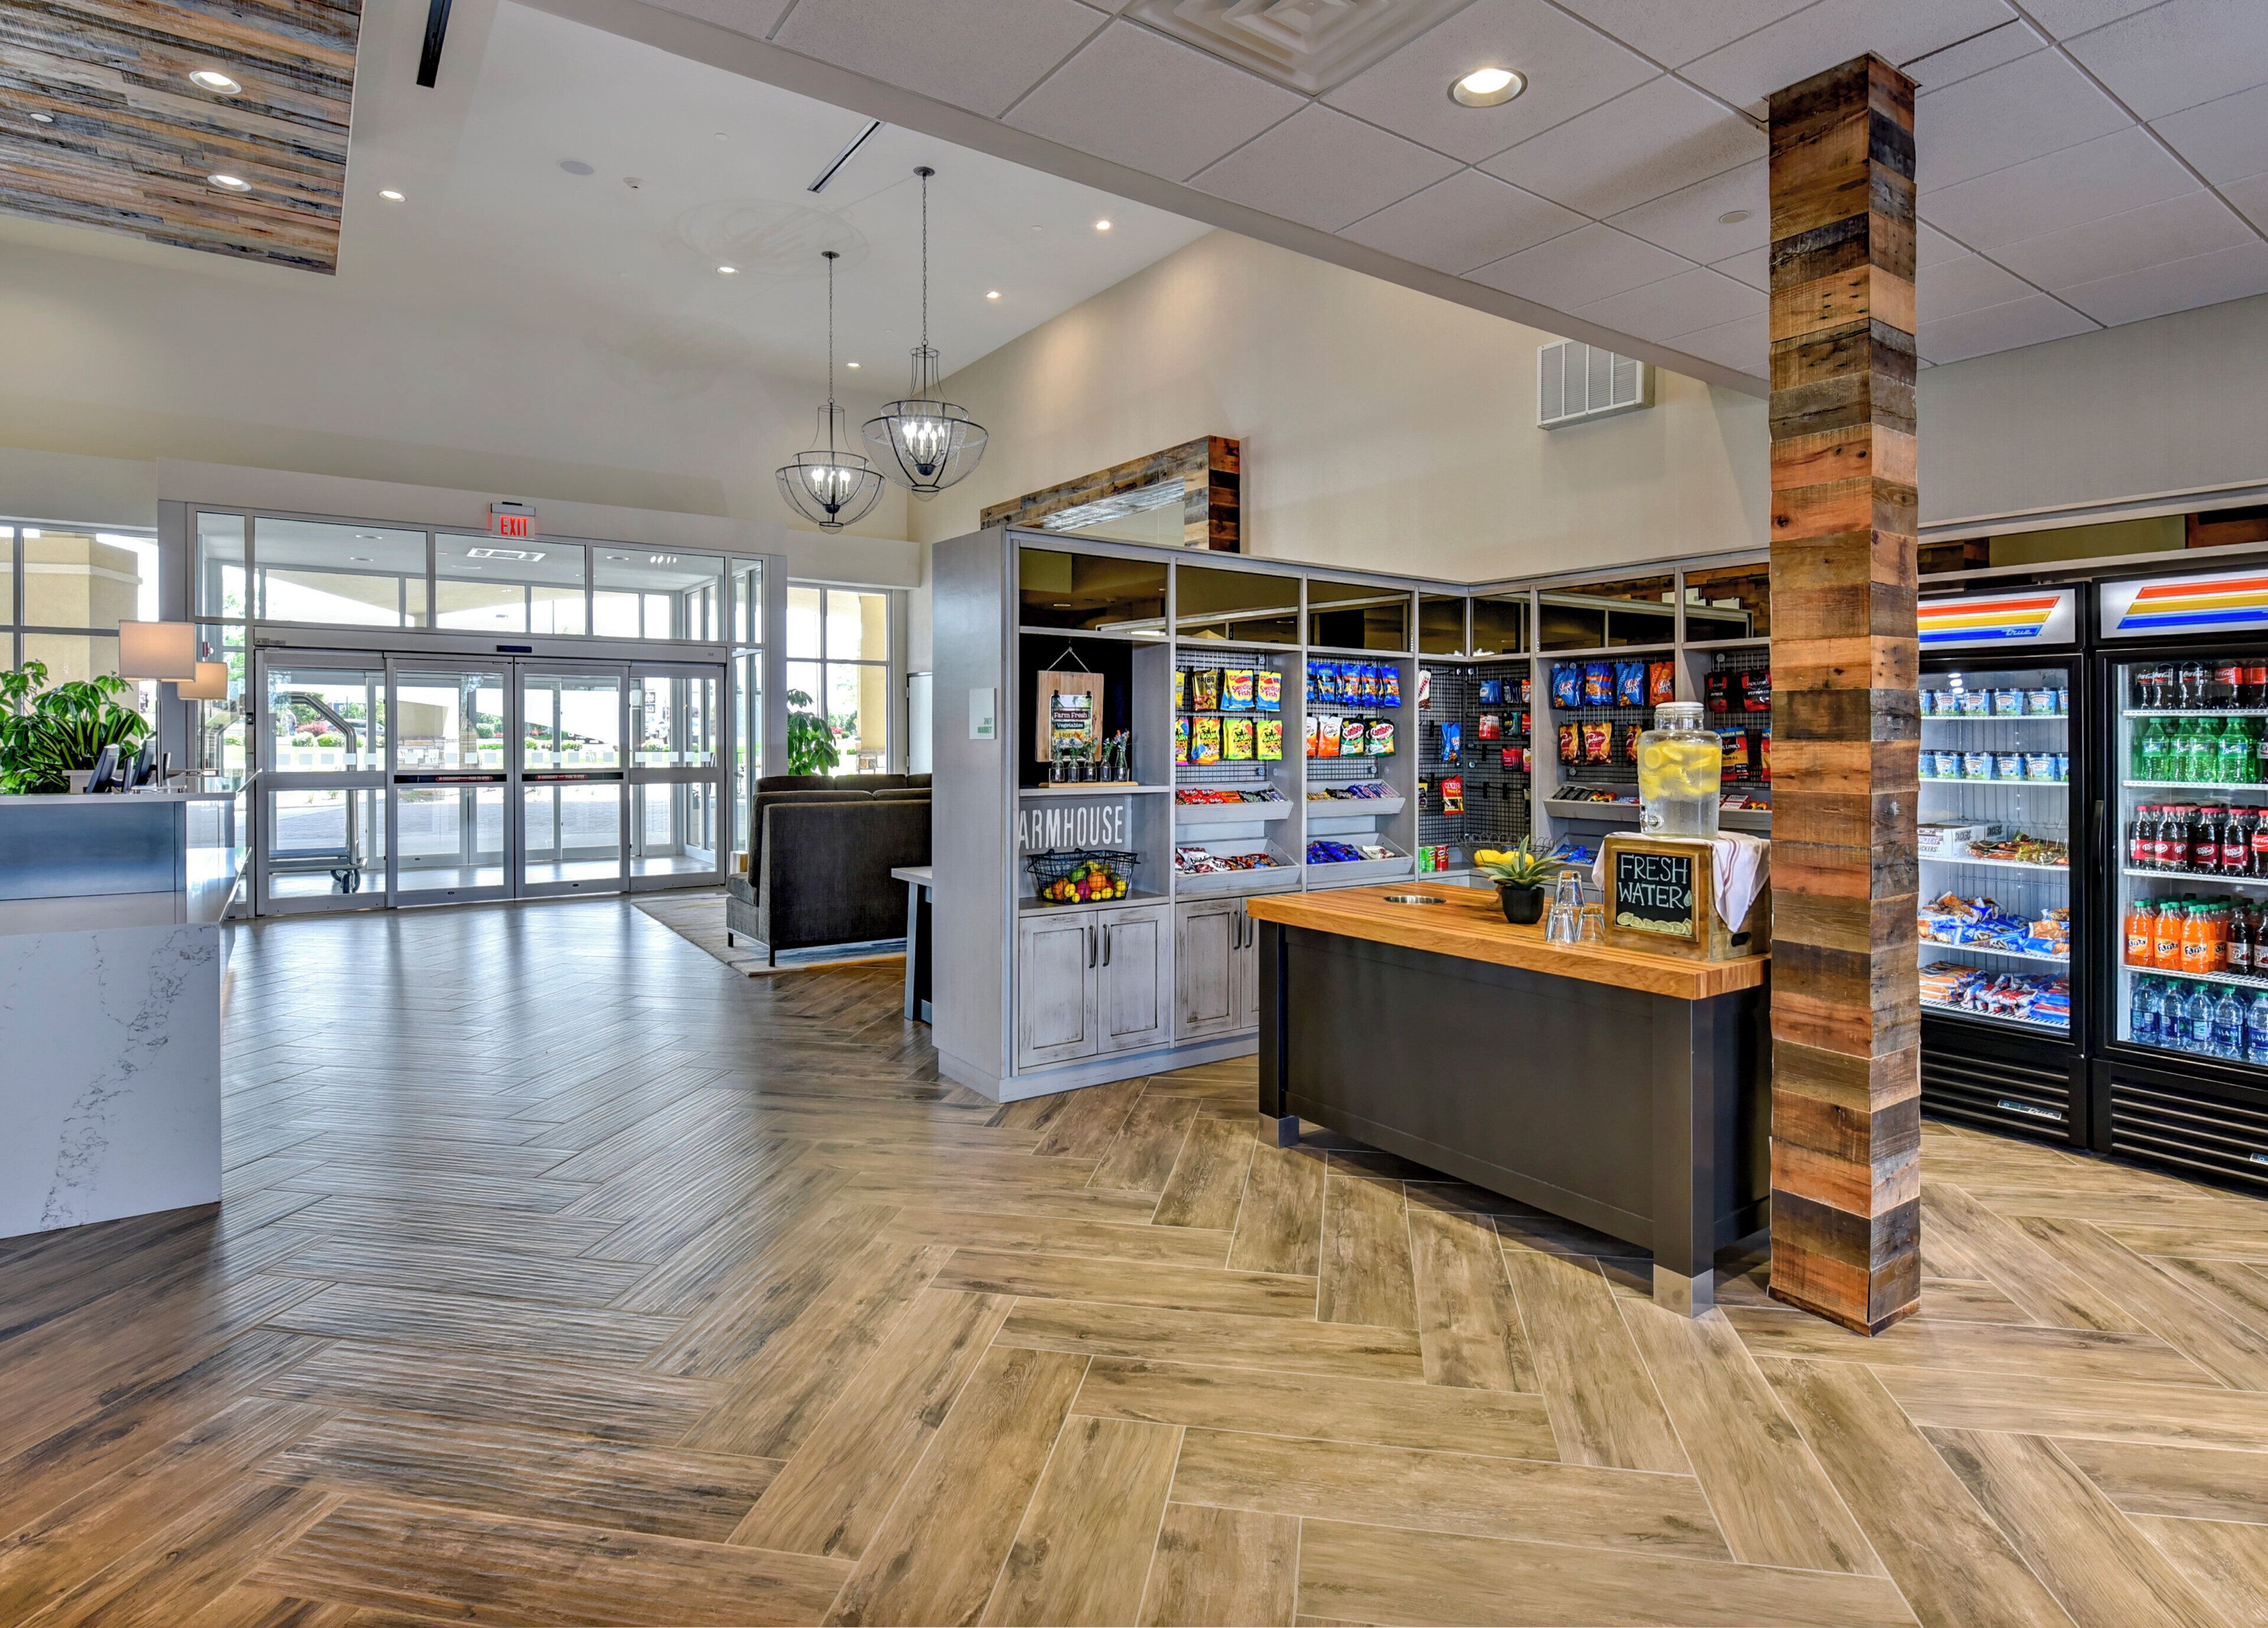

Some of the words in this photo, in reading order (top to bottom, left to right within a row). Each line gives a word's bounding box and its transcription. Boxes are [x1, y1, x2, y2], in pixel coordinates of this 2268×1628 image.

[500, 516, 529, 536] EXIT
[1371, 724, 1393, 737] Combos
[1019, 806, 1123, 849] ARMHOUSE
[1621, 854, 1688, 884] FRESH
[1618, 882, 1684, 909] WATER
[2129, 939, 2146, 948] anta
[2158, 942, 2178, 952] Fanta
[2185, 945, 2207, 955] Fanta
[2218, 1028, 2238, 1037] SANI
[2251, 1034, 2268, 1042] DASA
